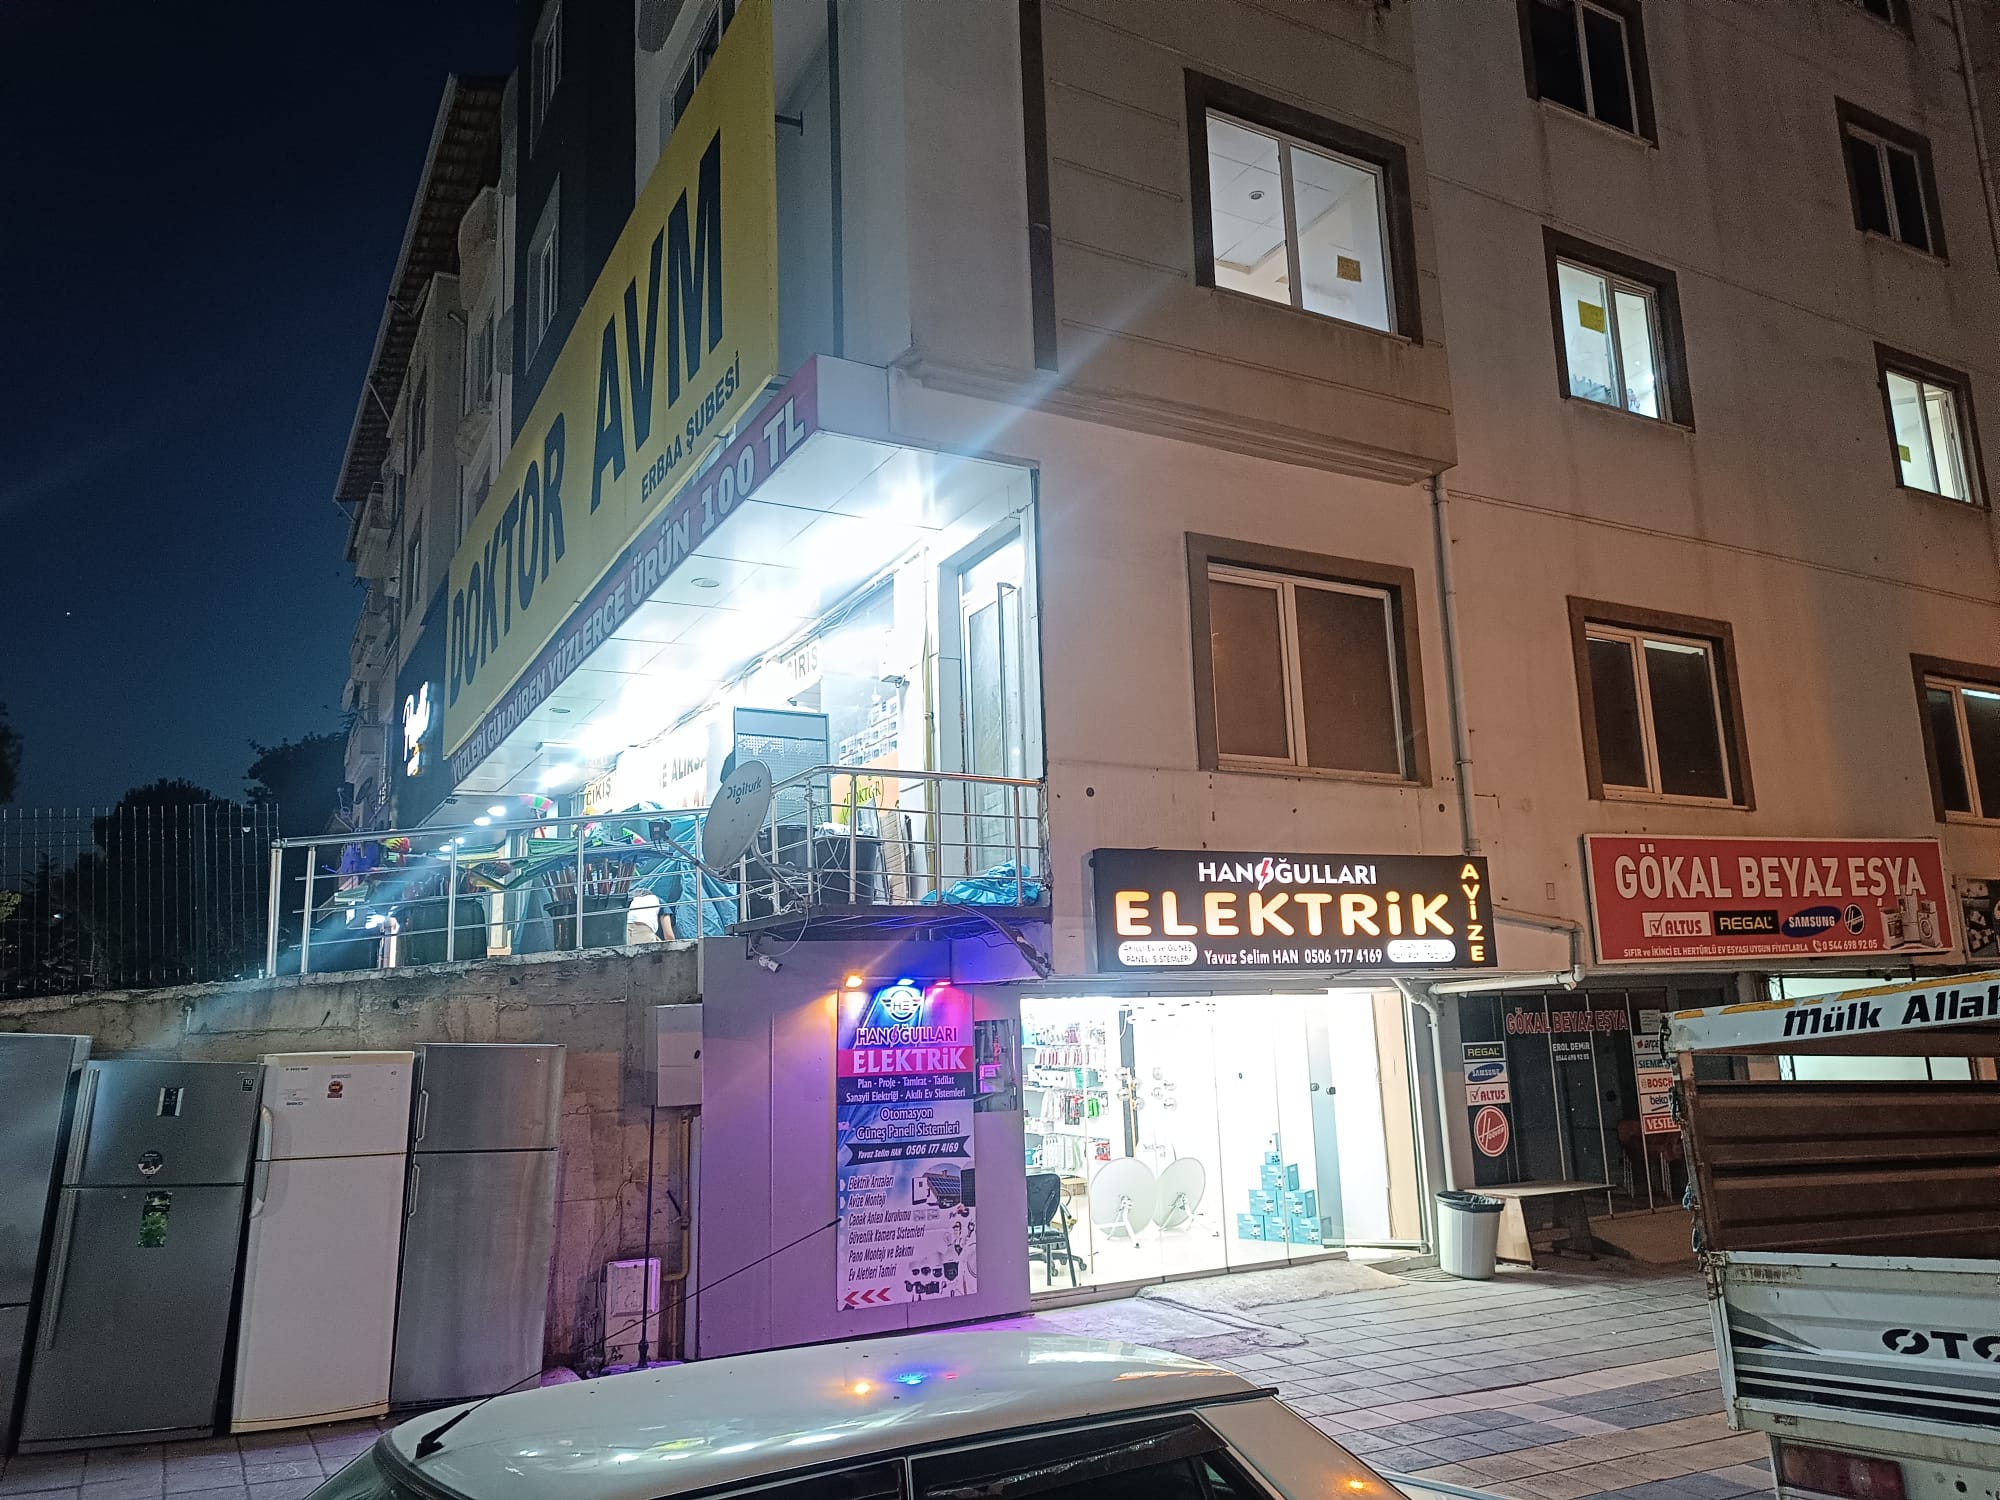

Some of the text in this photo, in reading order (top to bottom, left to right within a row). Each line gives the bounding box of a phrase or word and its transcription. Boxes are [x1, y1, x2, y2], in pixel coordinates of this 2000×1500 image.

[449, 126, 723, 709] DOKTOR AVM
[641, 351, 741, 504] ERBAA ŞUBESİ
[452, 395, 807, 786] YÜZLERİ GÜLDÜREN YÜZLERCE ÜRÜN 100 TL
[727, 776, 762, 804] Digiturk
[1199, 857, 1377, 889] HANOĞULLARI
[1614, 844, 1927, 907] GÖKAL BEYAZ EŞYA
[1665, 919, 1703, 935] ALTUS
[1719, 916, 1773, 930] REGAL
[1788, 915, 1836, 928] SAMSUNG
[1204, 949, 1237, 965] Yavuz
[1239, 948, 1270, 965] Selim
[1272, 949, 1299, 964] HAN
[1304, 949, 1332, 964] 0506
[1334, 948, 1354, 963] 177
[1356, 948, 1383, 963] 4169
[1624, 948, 1642, 958] SIFIR
[1651, 945, 1673, 957] İKİNCİ
[1673, 946, 1682, 956] EL
[1717, 946, 1726, 955] EV
[1749, 944, 1771, 954] UYGUN
[1830, 940, 1843, 950] 544
[1844, 940, 1857, 950] 698
[1506, 1007, 1552, 1035] GÖKAL
[1552, 1010, 1595, 1033] BEYAZ
[1595, 1009, 1629, 1037] EŞYA
[1783, 1001, 1883, 1037] Mülk
[856, 1024, 958, 1047] HANOĞULLARI
[1467, 1047, 1500, 1057] REGAL
[1552, 1043, 1570, 1052] EROL
[1643, 1039, 1661, 1053] arçe
[857, 1075, 955, 1089] Plan Proje Tamirat Tadilat
[1647, 1077, 1674, 1089] BOSCH
[924, 1090, 933, 1099] Ev
[934, 1087, 966, 1099] Sistemleri
[1480, 1089, 1506, 1101] ALTUS
[1649, 1095, 1669, 1105] beko
[880, 1107, 934, 1121] Otomasyon
[856, 1120, 960, 1141] Güneş Paneli Sistemleri
[905, 1144, 926, 1156] 0506
[927, 1143, 941, 1154] 177
[941, 1142, 959, 1153] 4169
[848, 1193, 864, 1208] Avize
[874, 1228, 896, 1242] Kamera
[896, 1224, 926, 1240] Sistemleri
[848, 1250, 864, 1263] Pano
[879, 1263, 897, 1278] Tamiri
